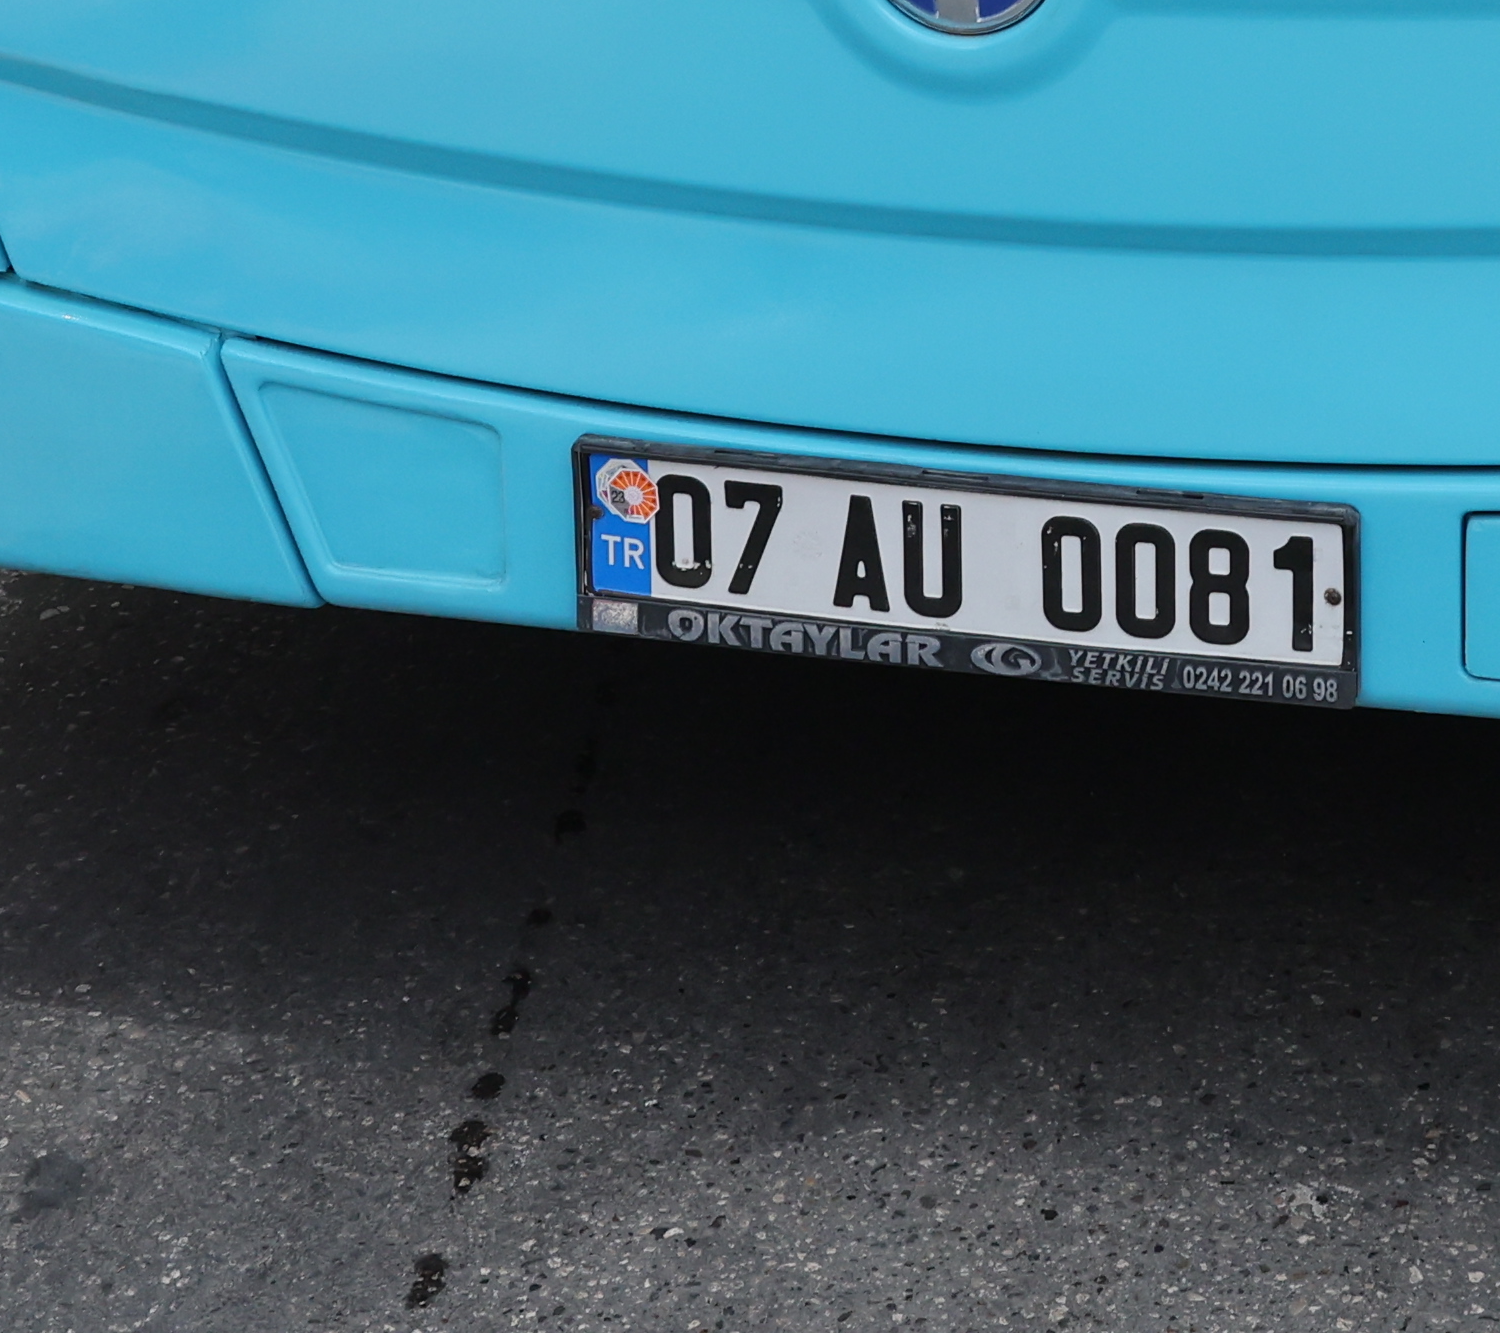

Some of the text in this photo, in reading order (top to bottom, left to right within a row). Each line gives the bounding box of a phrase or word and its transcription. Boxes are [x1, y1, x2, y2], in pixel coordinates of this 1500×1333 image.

[601, 533, 646, 571] TR
[654, 473, 1315, 653] 07 AU 0081
[667, 609, 945, 669] OKTAYLAR
[1182, 666, 1338, 703] 0242 221 06 98
